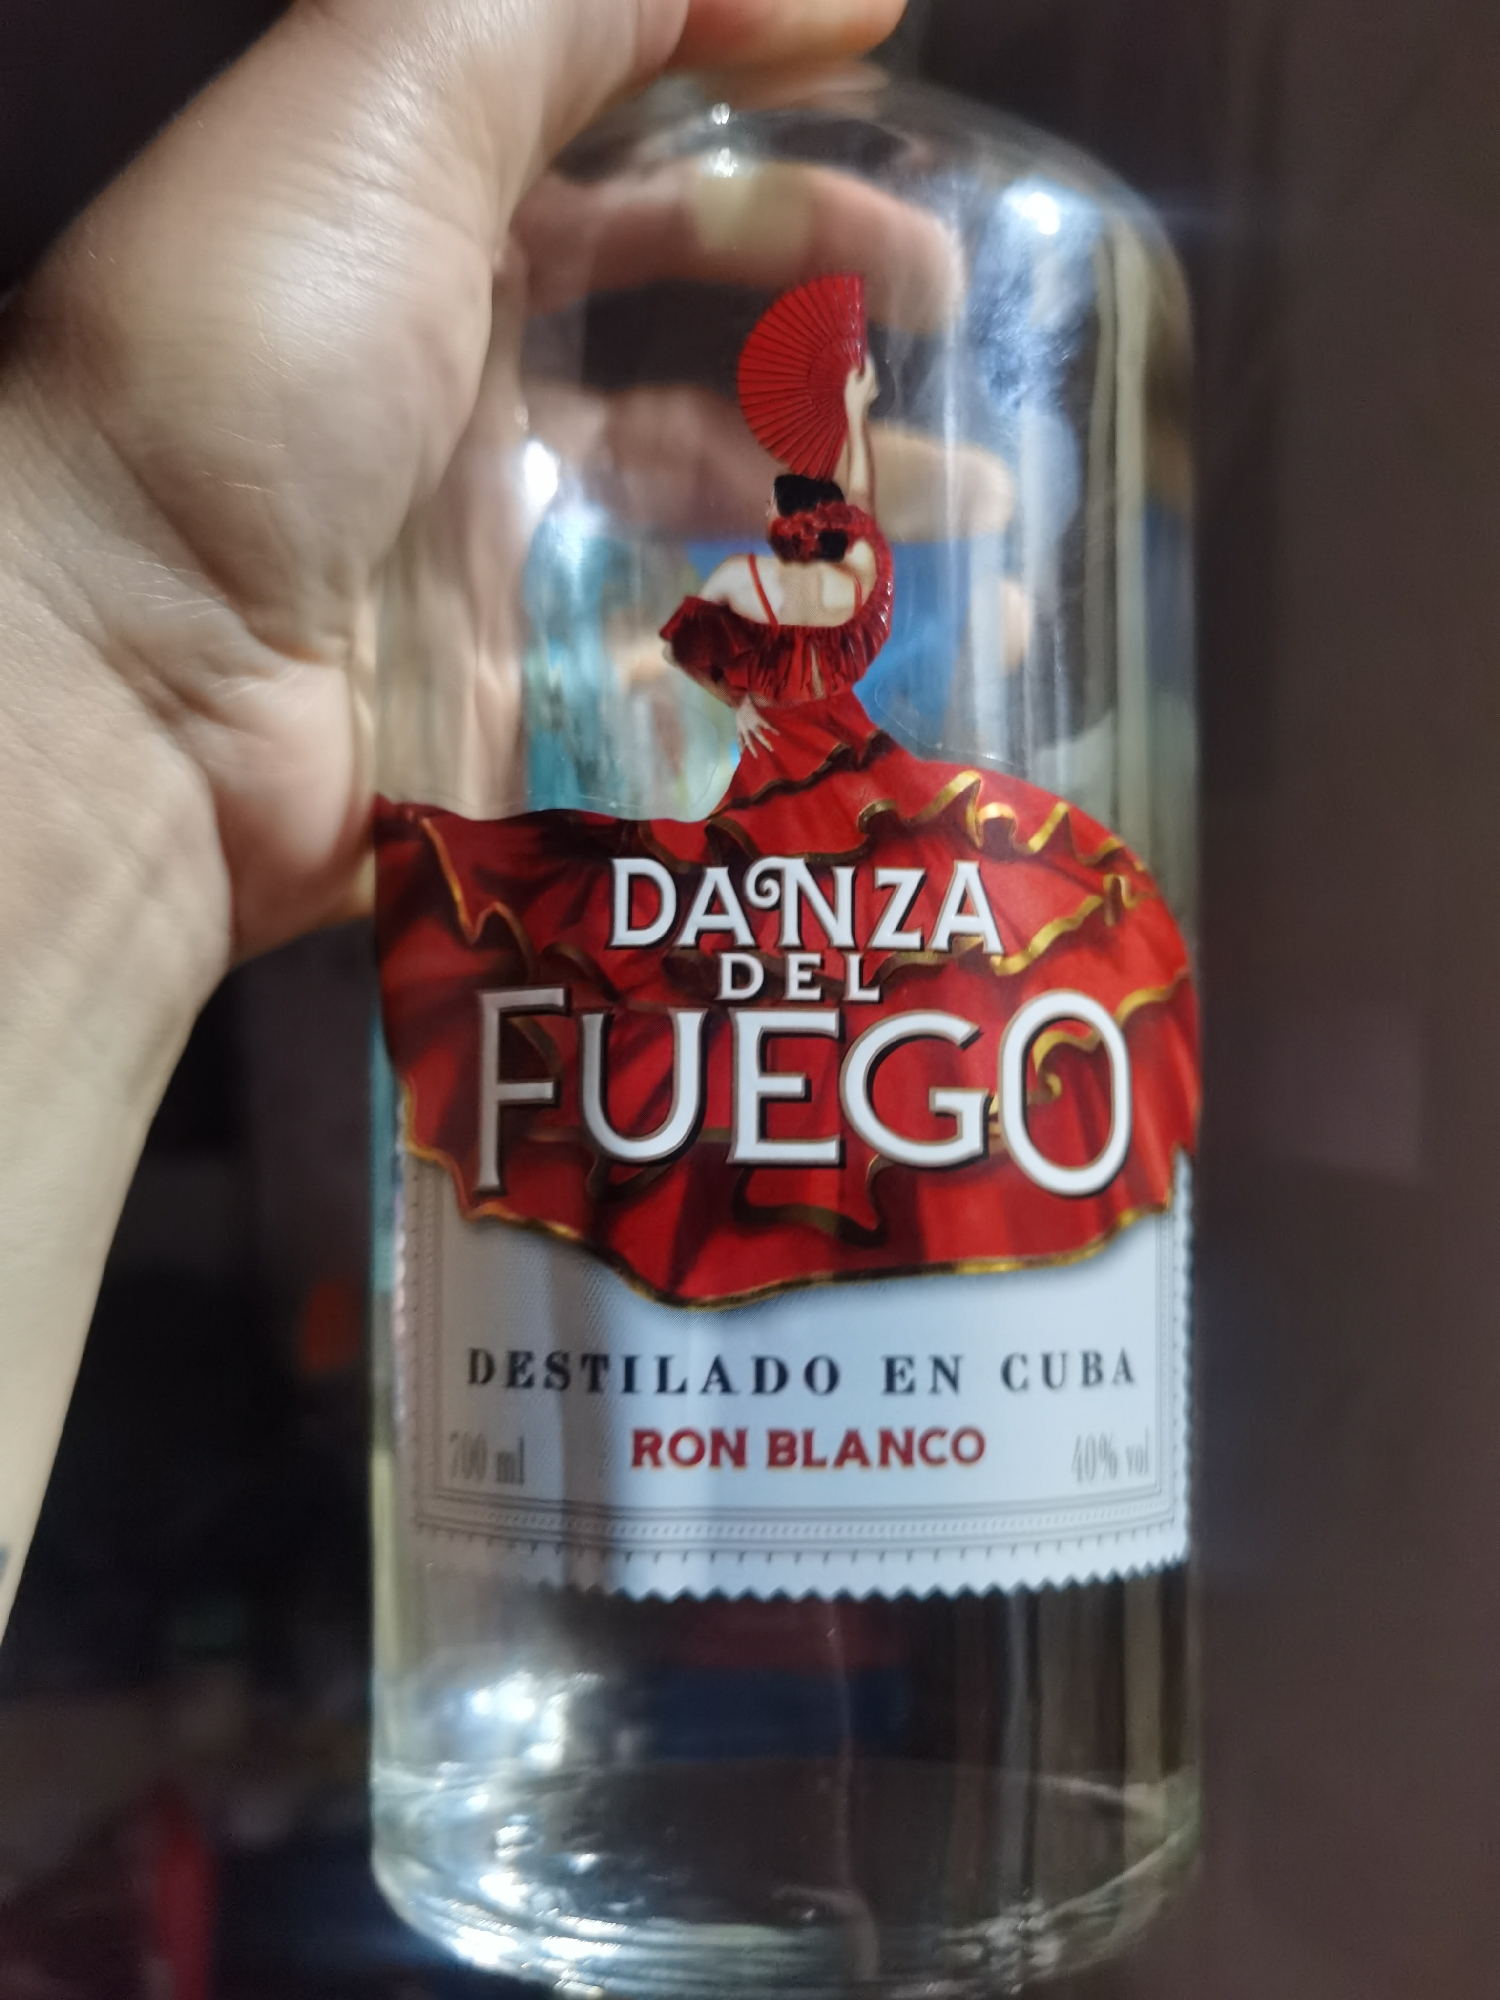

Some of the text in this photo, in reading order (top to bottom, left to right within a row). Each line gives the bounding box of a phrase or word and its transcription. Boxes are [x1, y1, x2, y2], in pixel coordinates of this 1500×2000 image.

[610, 858, 1003, 954] DANZA
[719, 953, 881, 1003] DEL
[474, 988, 1131, 1195] FUEGO
[468, 1348, 1135, 1396] DESTILADO EN CUBA
[632, 1426, 986, 1469] RON BLANCO
[1070, 1427, 1150, 1484] 40% vol
